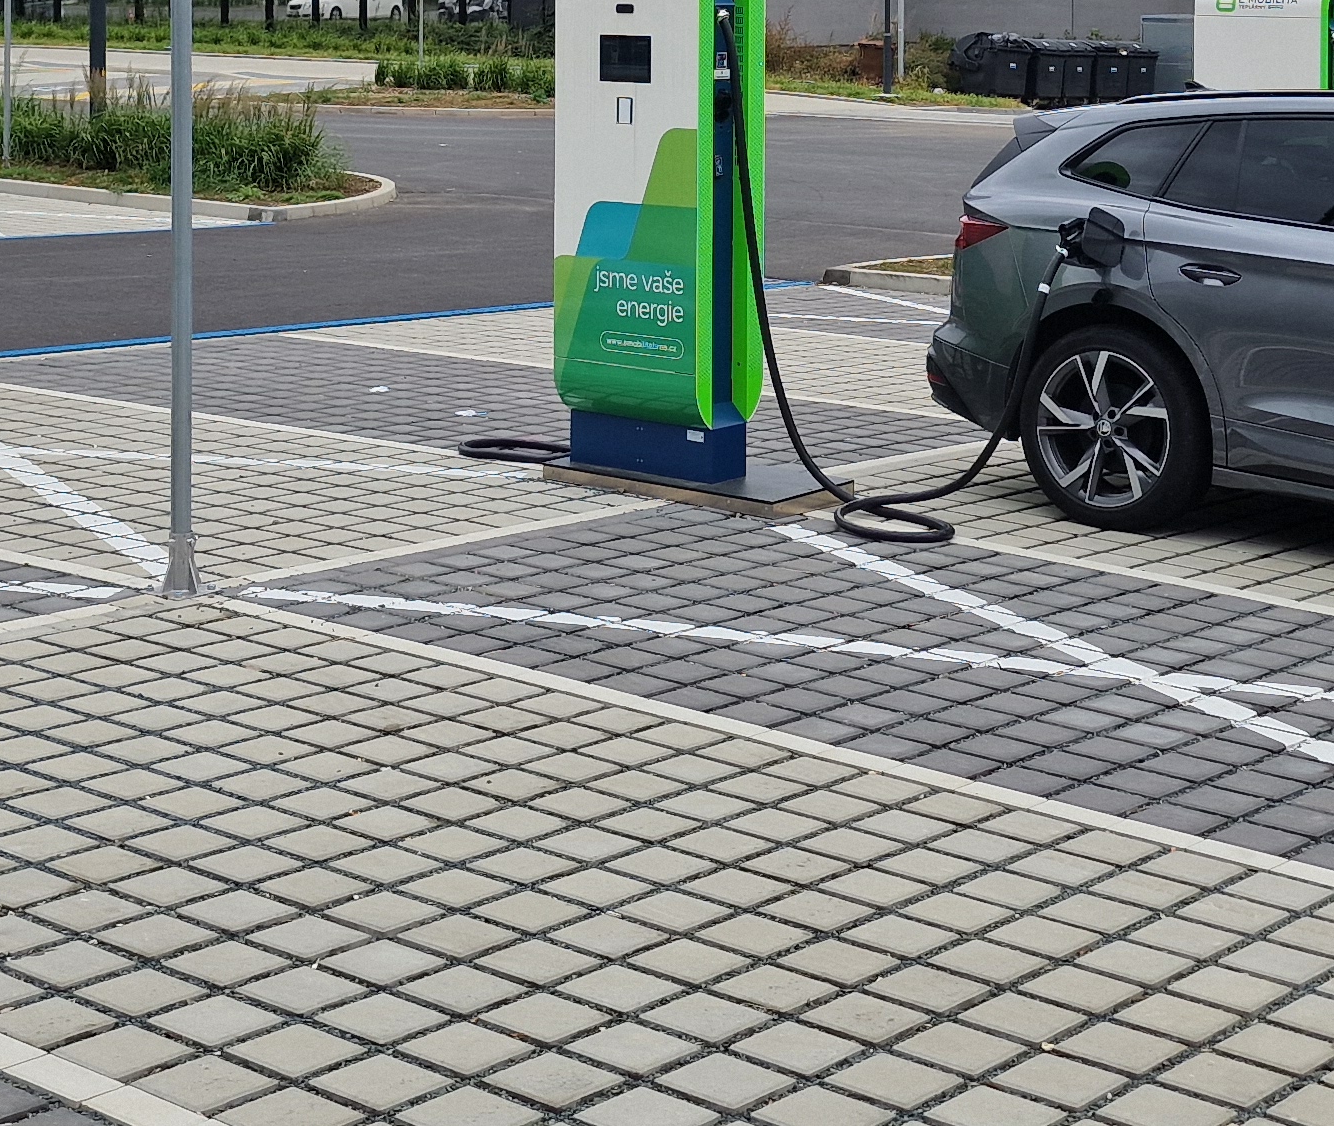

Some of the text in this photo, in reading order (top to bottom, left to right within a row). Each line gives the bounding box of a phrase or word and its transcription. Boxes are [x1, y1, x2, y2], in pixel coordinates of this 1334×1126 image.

[593, 265, 684, 295] jsme vaše
[616, 299, 684, 327] energie
